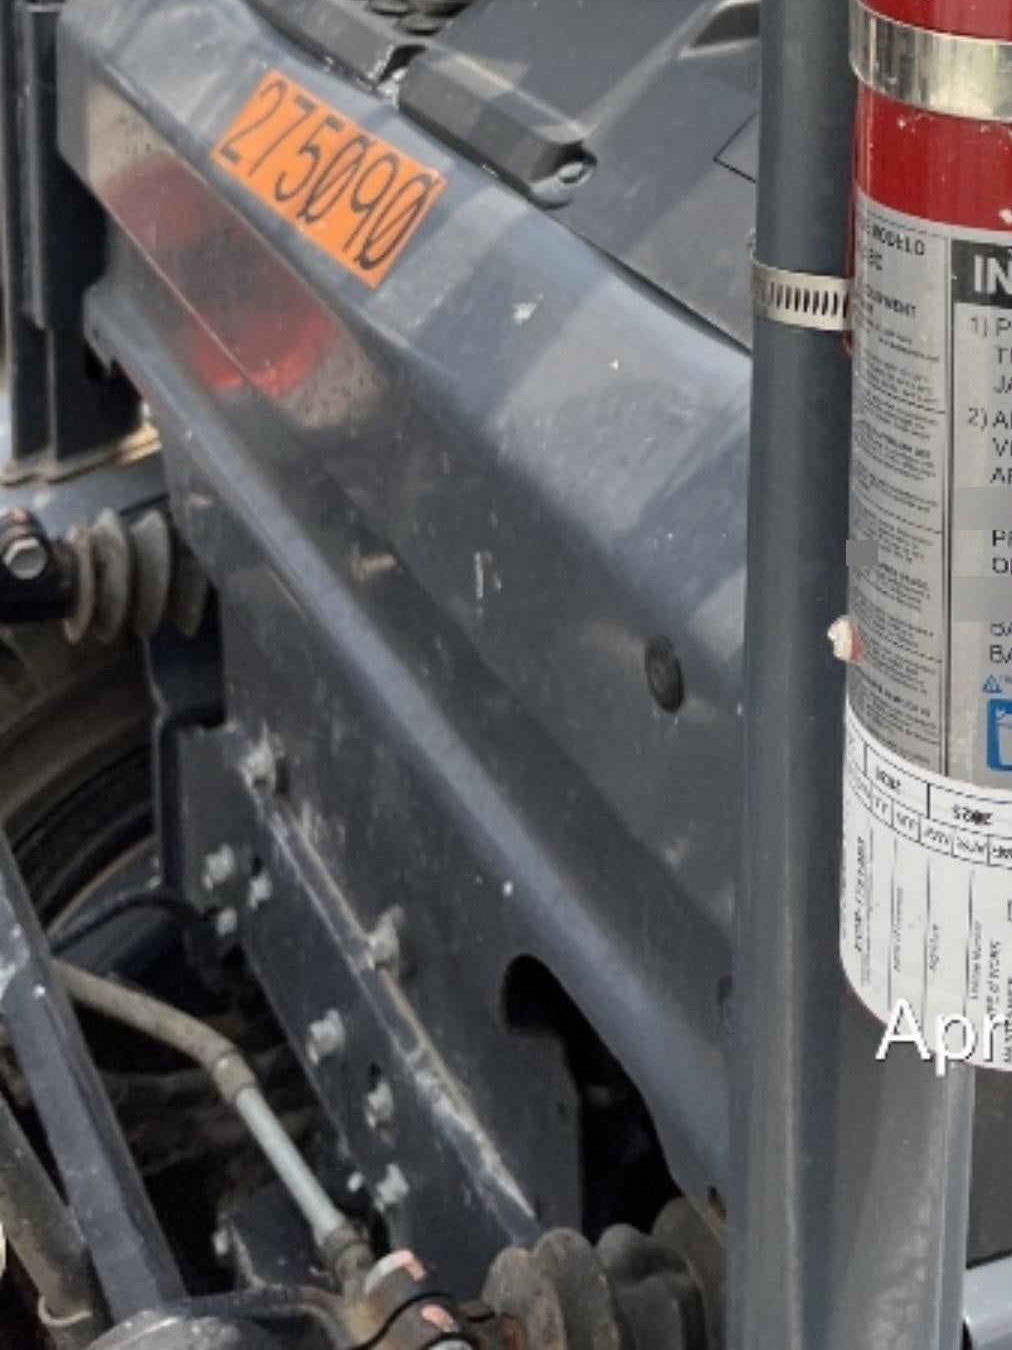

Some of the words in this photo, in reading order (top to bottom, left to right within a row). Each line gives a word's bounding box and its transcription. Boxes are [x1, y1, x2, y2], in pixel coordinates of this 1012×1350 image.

[218, 78, 438, 272] 275090
[971, 317, 989, 340] 1)
[967, 408, 987, 431] 2)
